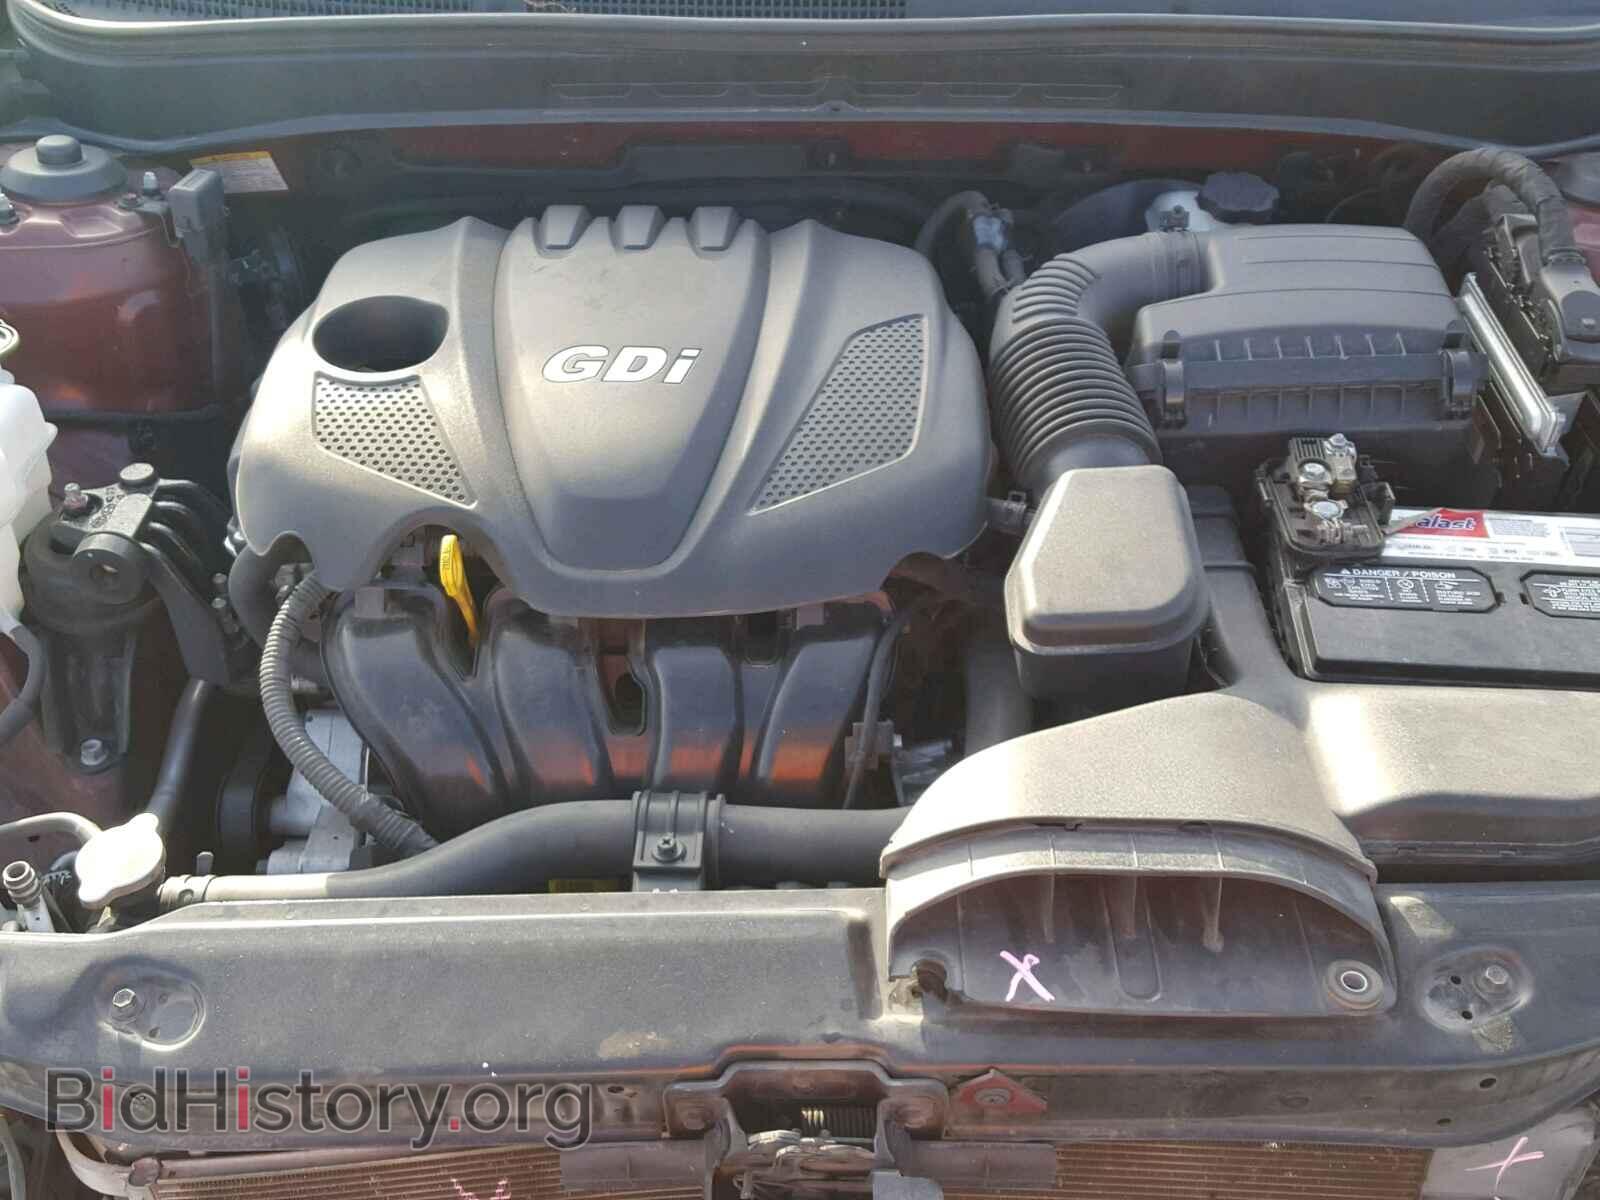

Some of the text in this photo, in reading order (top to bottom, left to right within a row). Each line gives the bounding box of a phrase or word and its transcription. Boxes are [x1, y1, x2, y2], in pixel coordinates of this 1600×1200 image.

[541, 344, 703, 384] GDi
[1415, 513, 1477, 531] alast
[1352, 568, 1400, 577] DANGER
[1412, 570, 1457, 579] POISON
